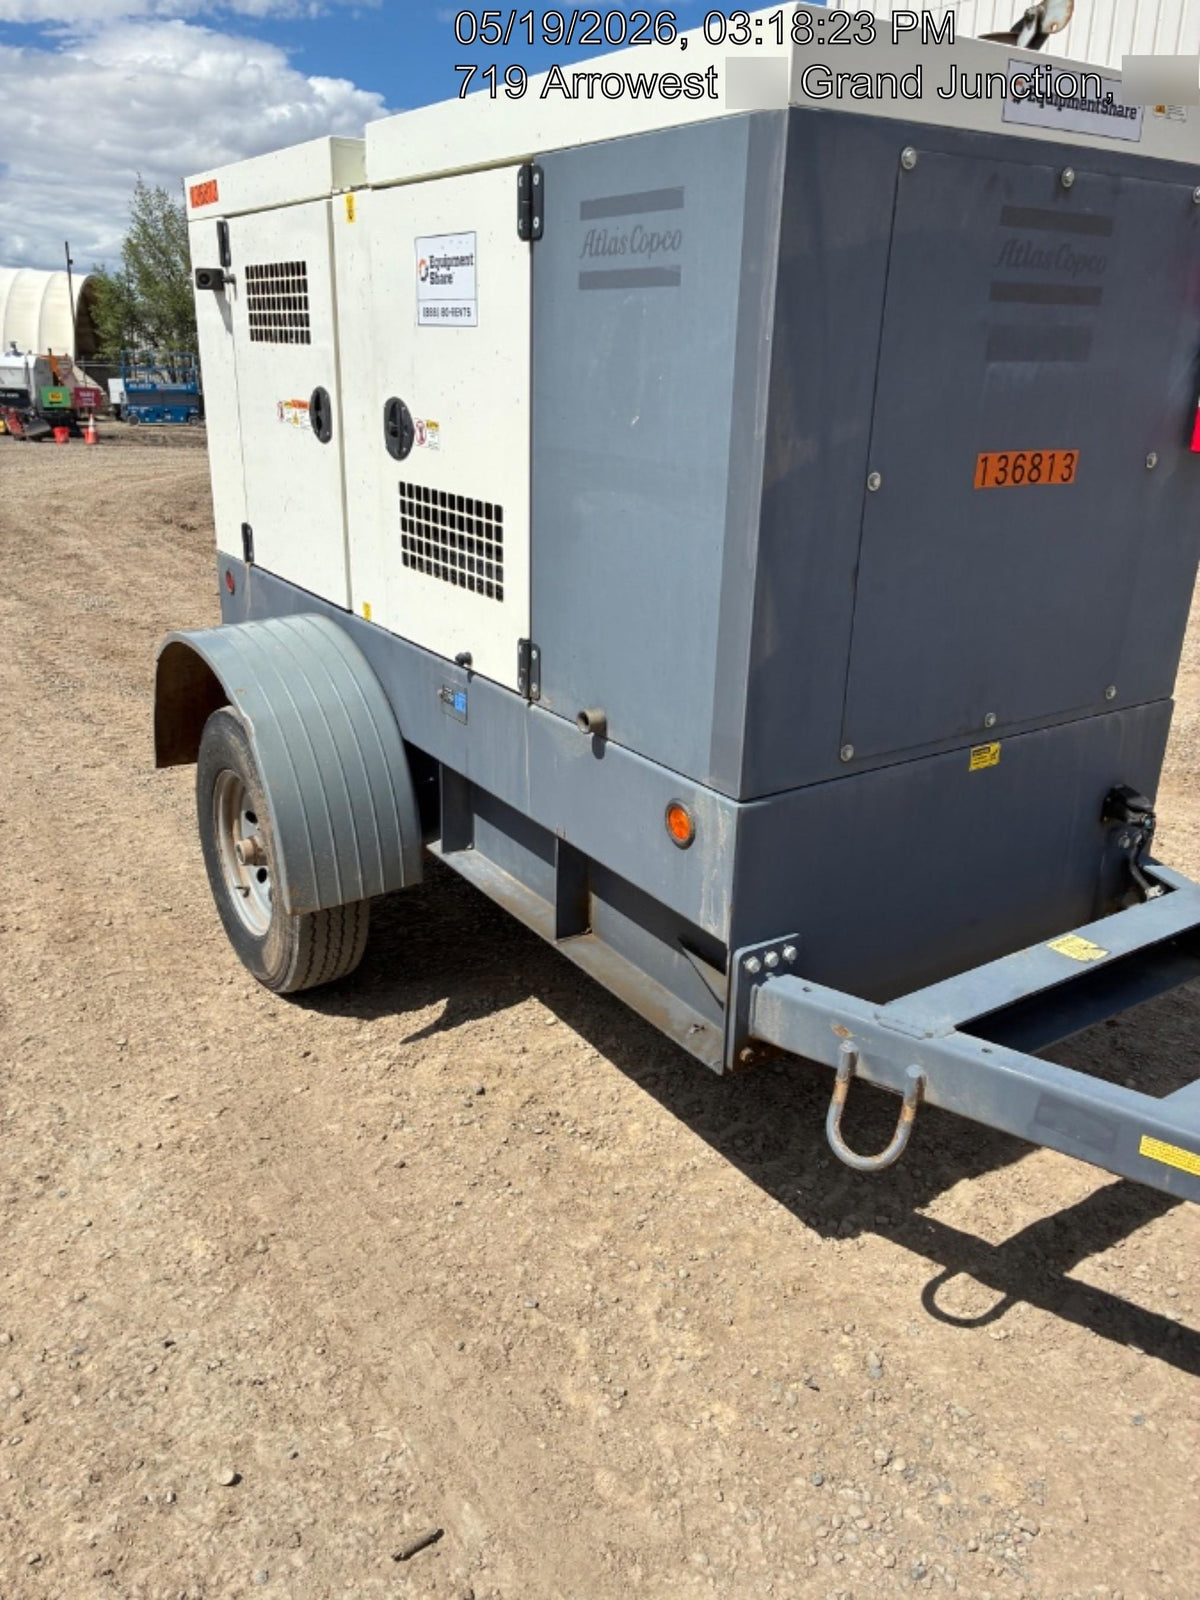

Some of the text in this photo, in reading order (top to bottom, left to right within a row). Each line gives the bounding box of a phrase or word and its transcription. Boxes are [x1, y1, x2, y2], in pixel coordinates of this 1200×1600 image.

[579, 224, 682, 260] Atlas Copco
[429, 254, 474, 271] Equipment
[429, 271, 453, 285] Share
[980, 453, 1075, 486] 136813
